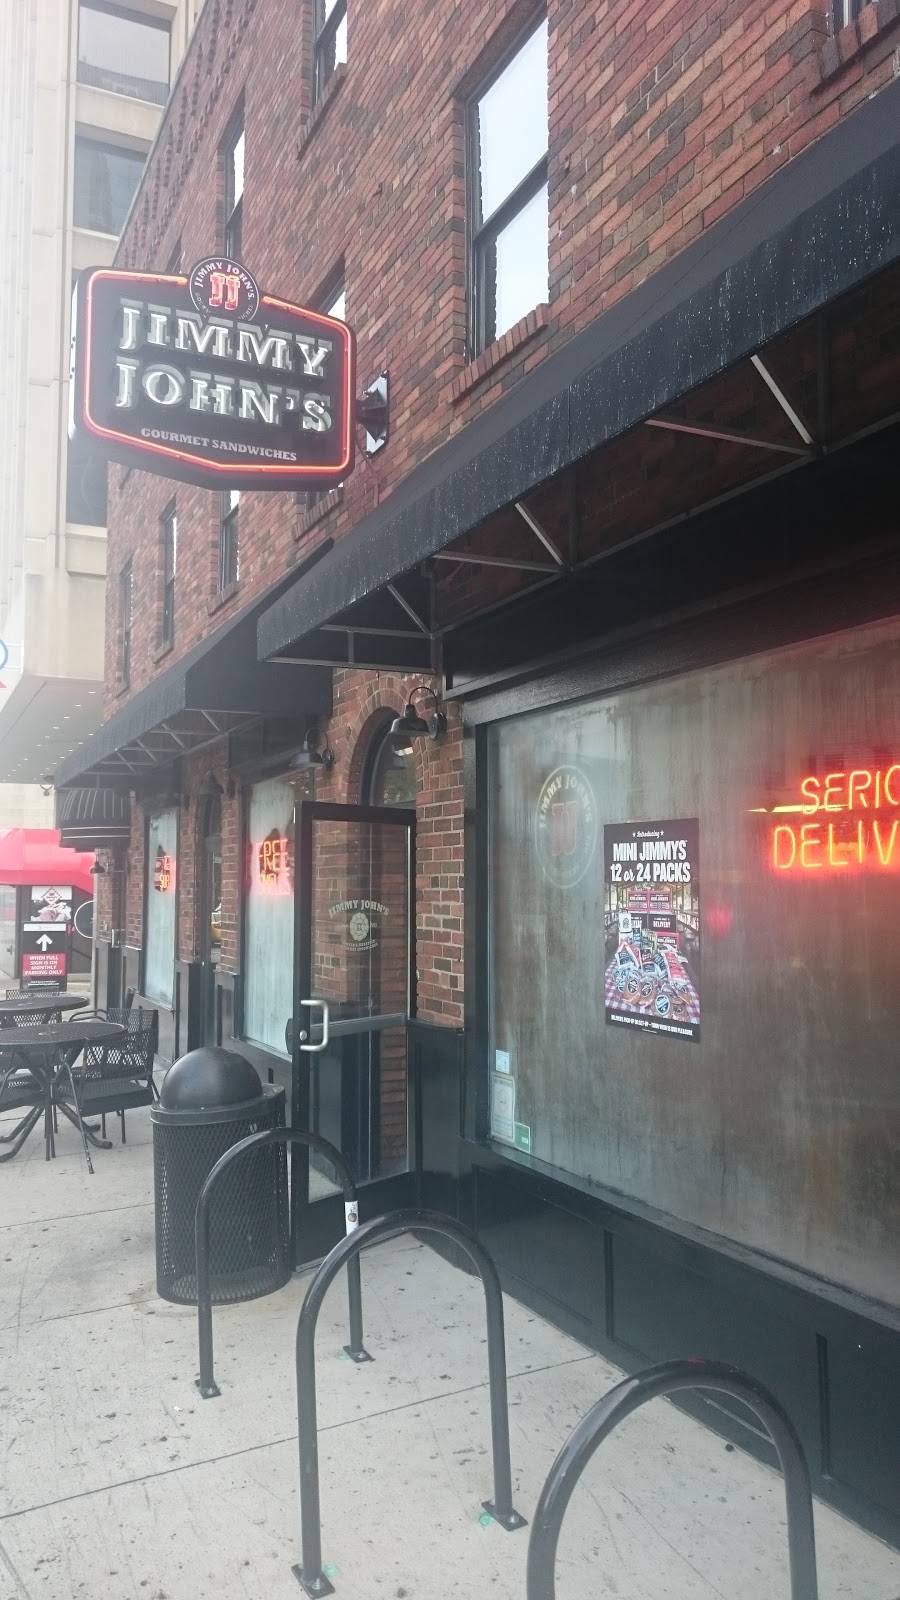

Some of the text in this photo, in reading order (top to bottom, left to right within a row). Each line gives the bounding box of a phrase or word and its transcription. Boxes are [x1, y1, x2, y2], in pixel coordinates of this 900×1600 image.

[194, 262, 255, 299] JIMMY JOHN'S
[119, 298, 332, 378] JIMMY
[115, 355, 332, 433] JOHN'S
[140, 427, 298, 461] GOURMET SANDWICHES
[612, 842, 638, 862] MINI
[639, 840, 687, 862] JIMMYS
[610, 861, 691, 882] 12 or 24 PACKS
[328, 899, 359, 920] JIMMY
